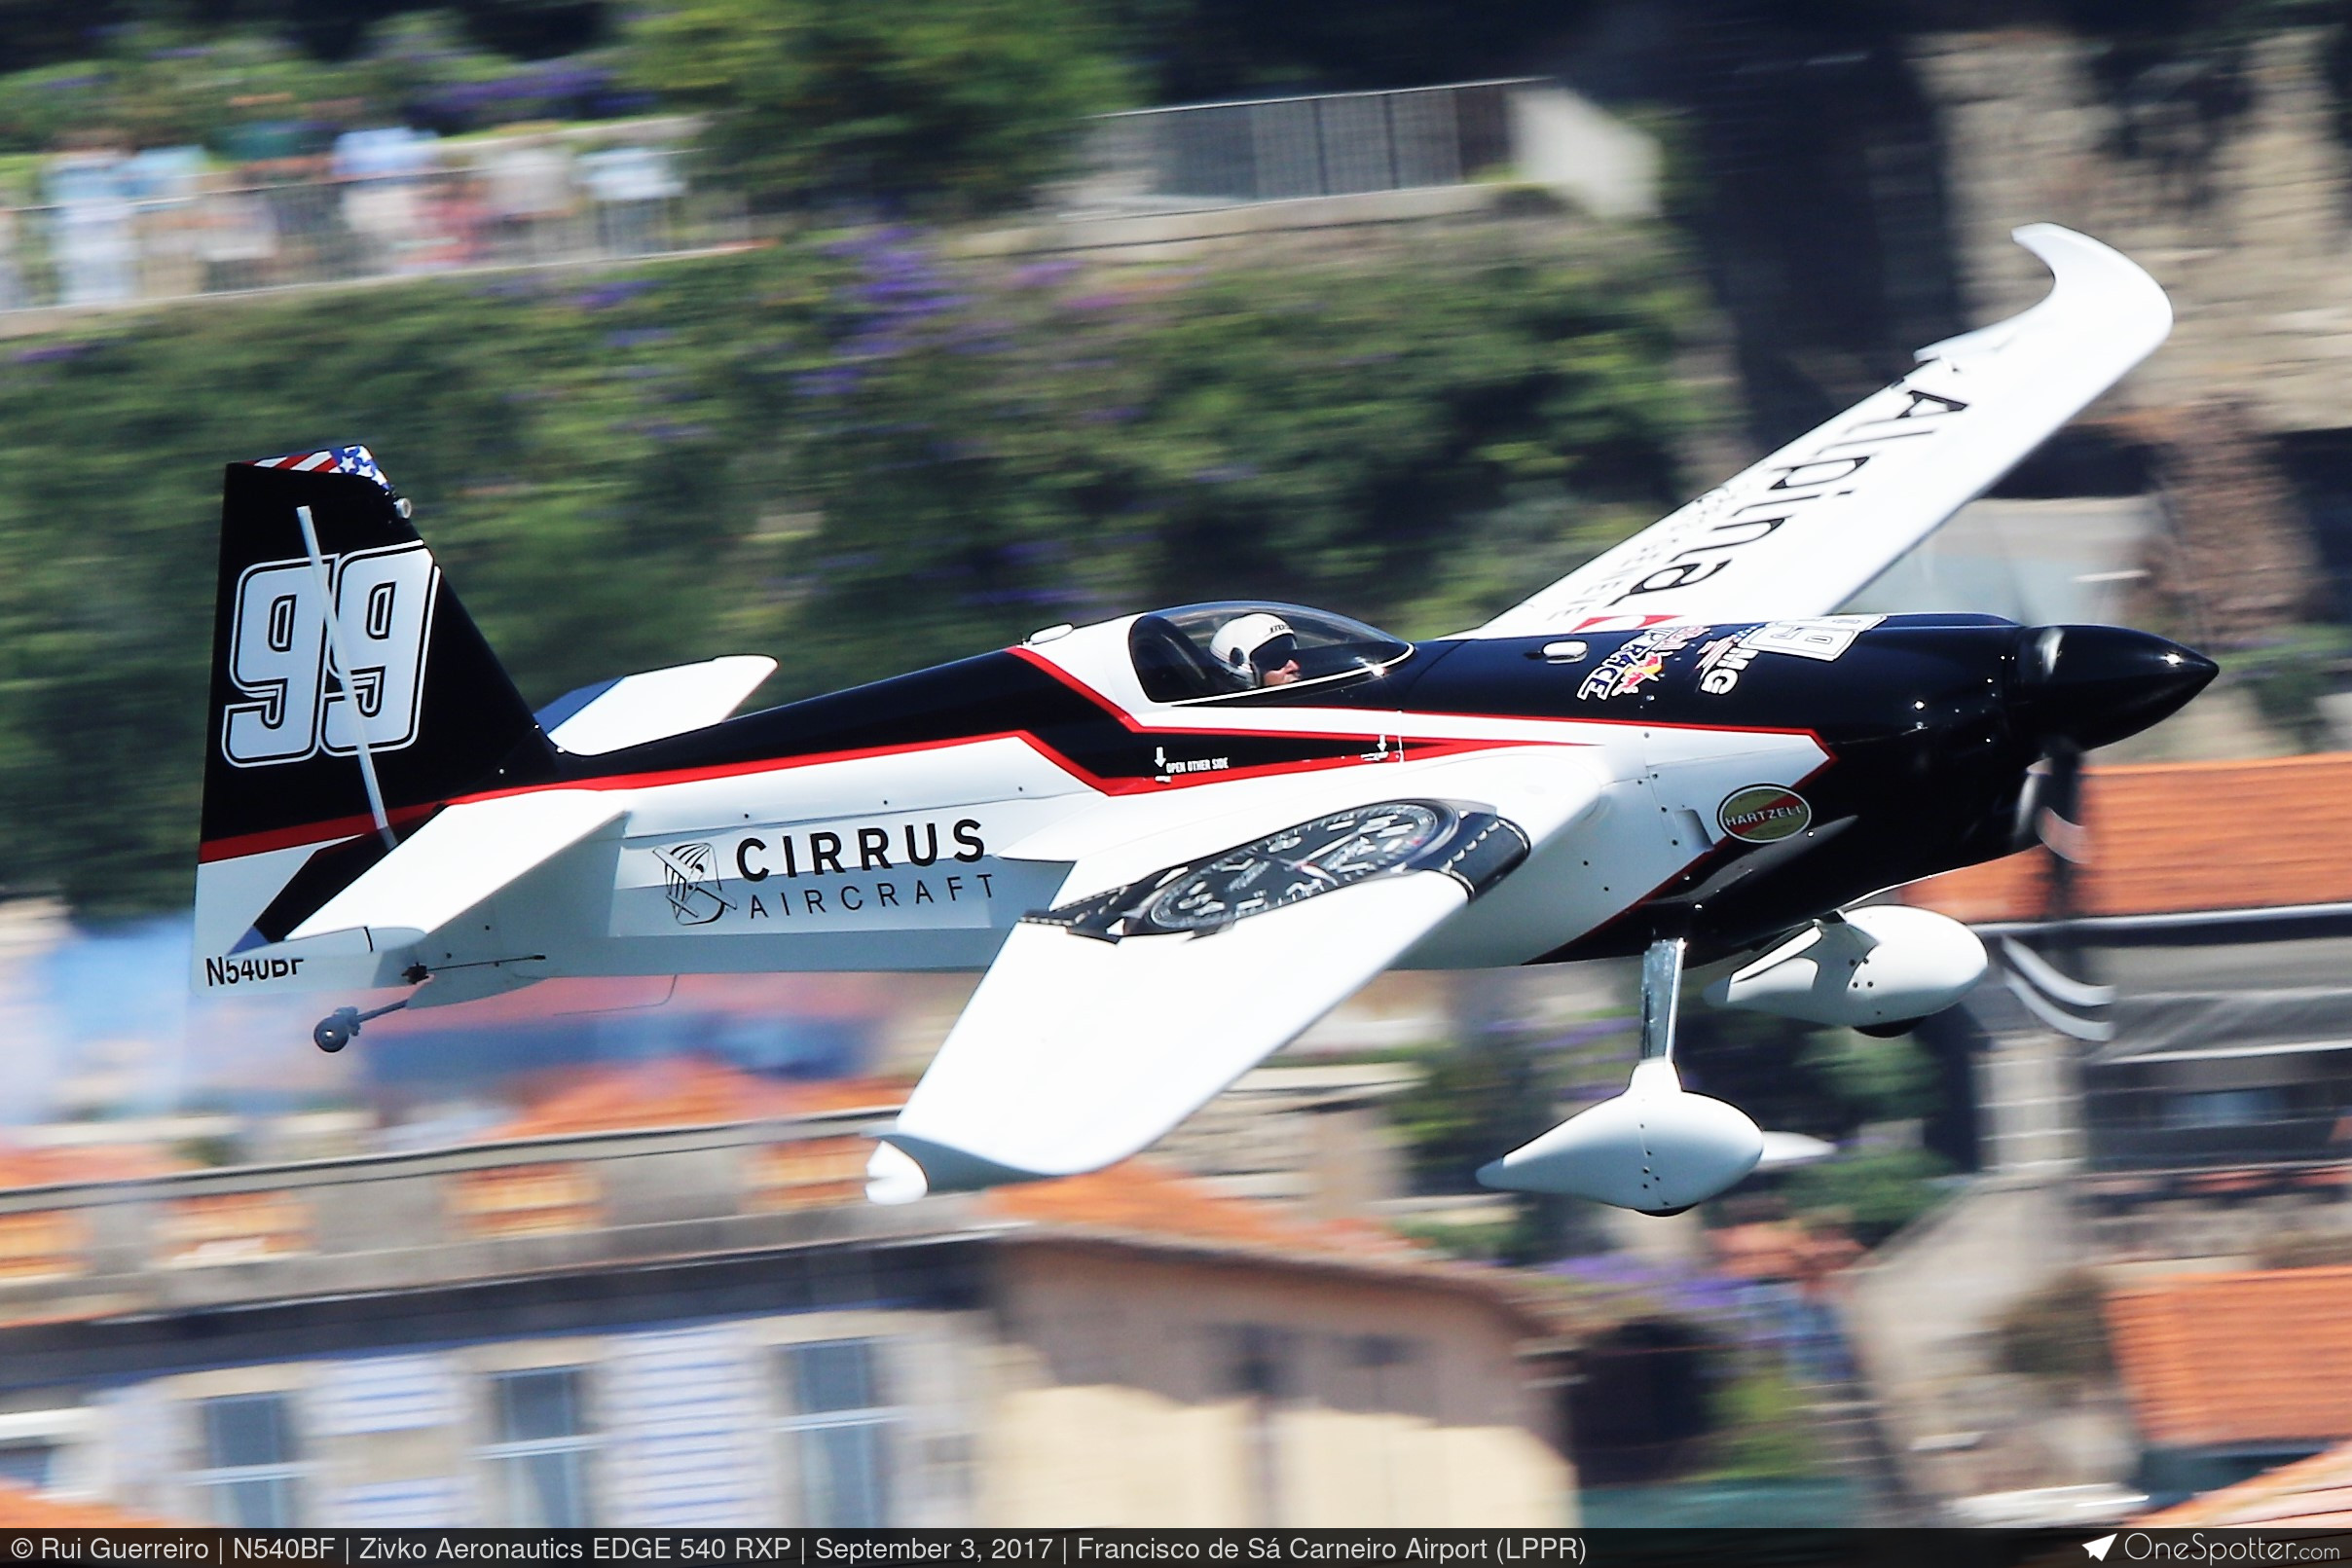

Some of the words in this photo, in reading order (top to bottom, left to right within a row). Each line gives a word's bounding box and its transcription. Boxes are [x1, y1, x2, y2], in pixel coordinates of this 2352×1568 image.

[1603, 389, 1970, 608] Alpina
[221, 540, 441, 768] 99
[1166, 762, 1186, 774] OPEN
[1187, 759, 1211, 772] OTHER
[1212, 756, 1230, 770] SIDE
[736, 819, 985, 882] CIRRUS
[751, 873, 994, 920] AIRCRAFT
